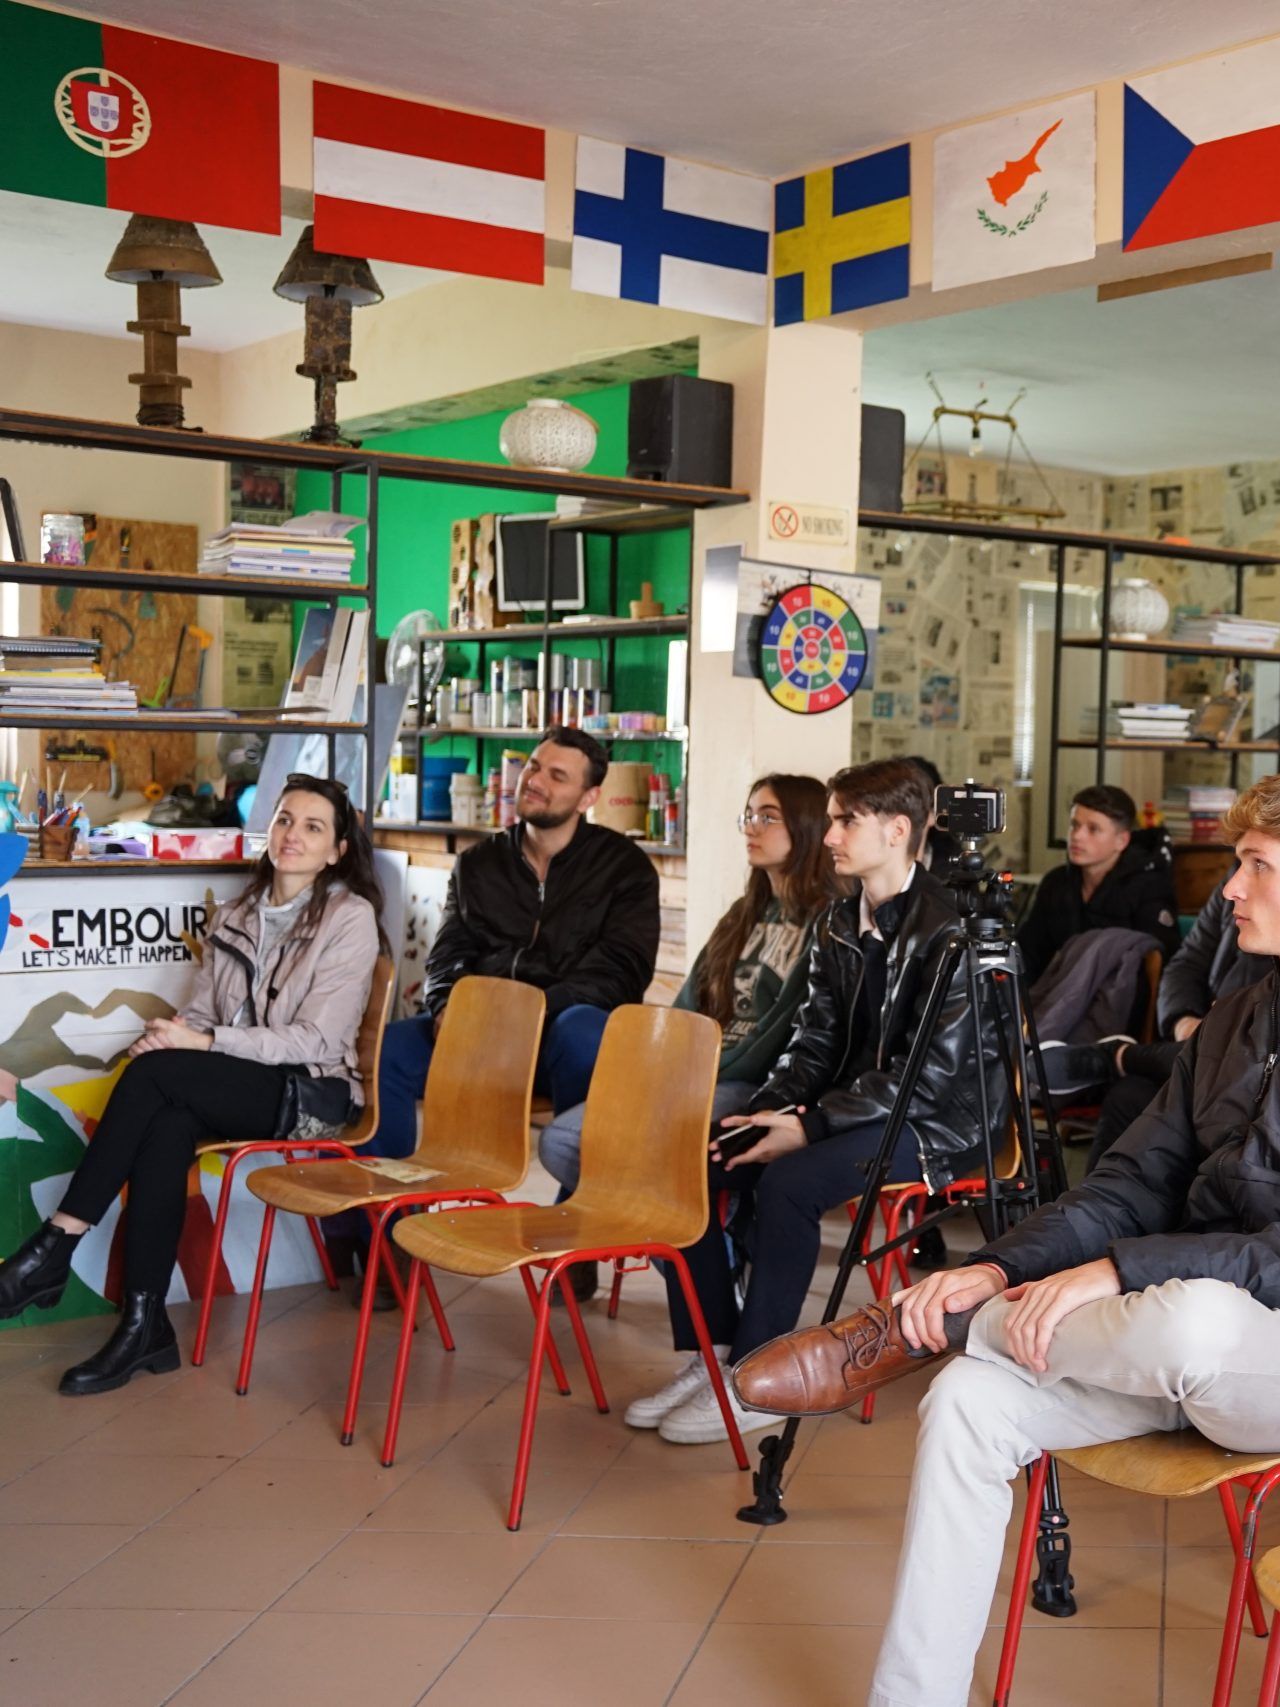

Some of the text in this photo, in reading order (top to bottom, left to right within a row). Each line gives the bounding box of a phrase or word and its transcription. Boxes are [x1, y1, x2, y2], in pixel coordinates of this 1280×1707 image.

[770, 625, 780, 636] 10
[847, 666, 859, 677] 10
[22, 944, 192, 968] LET'S MAKE IT HAPPEN
